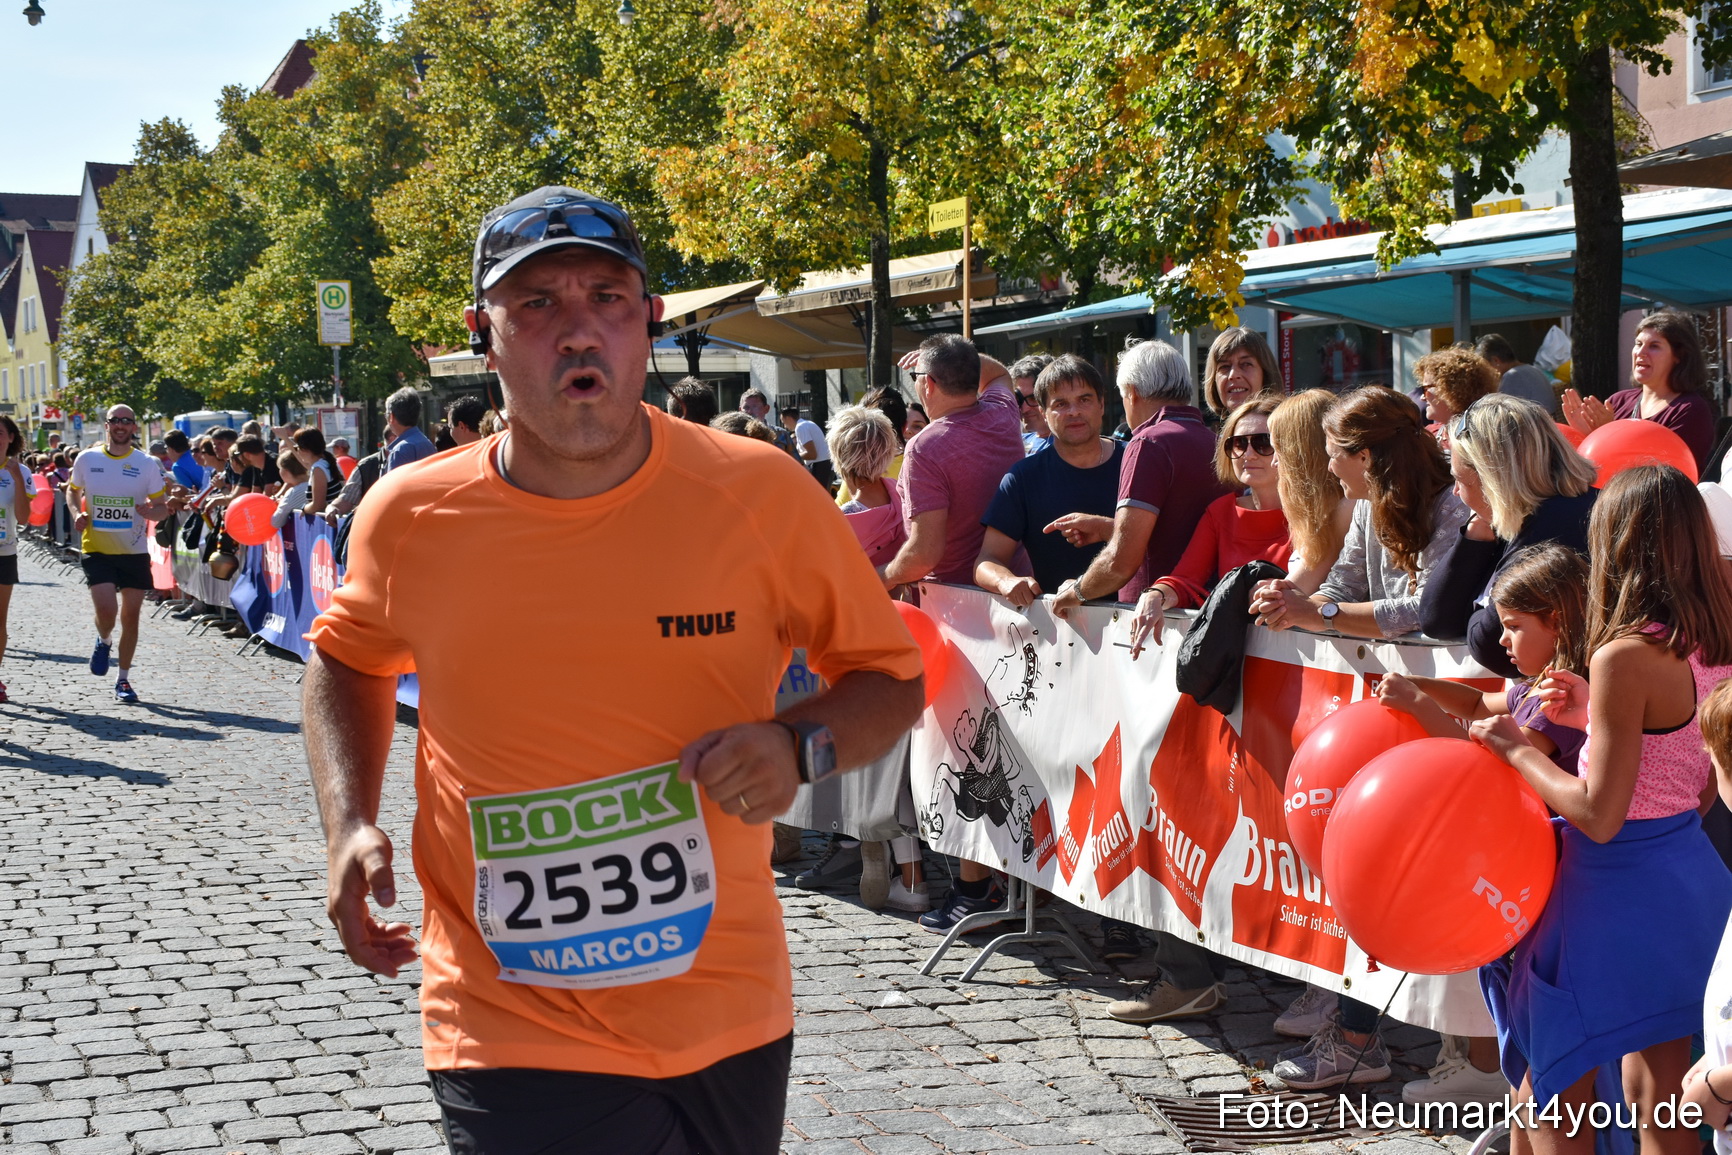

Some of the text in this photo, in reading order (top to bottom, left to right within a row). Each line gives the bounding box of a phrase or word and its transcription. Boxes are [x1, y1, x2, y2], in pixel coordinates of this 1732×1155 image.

[935, 208, 964, 223] Toiletten
[1282, 328, 1291, 359] Store
[95, 497, 130, 506] BOCK
[96, 508, 129, 519] 2804
[656, 611, 736, 638] THULE
[1227, 752, 1239, 794] Seit 1929
[486, 776, 677, 848] BOCK
[1092, 811, 1129, 870] Braun
[1141, 784, 1207, 887] Braun
[503, 841, 688, 930] 2539
[686, 838, 698, 850] D
[1165, 856, 1177, 881] Sicher
[1280, 905, 1308, 928] Sicher
[1310, 913, 1322, 931] ist
[529, 925, 683, 970] MARCOS
